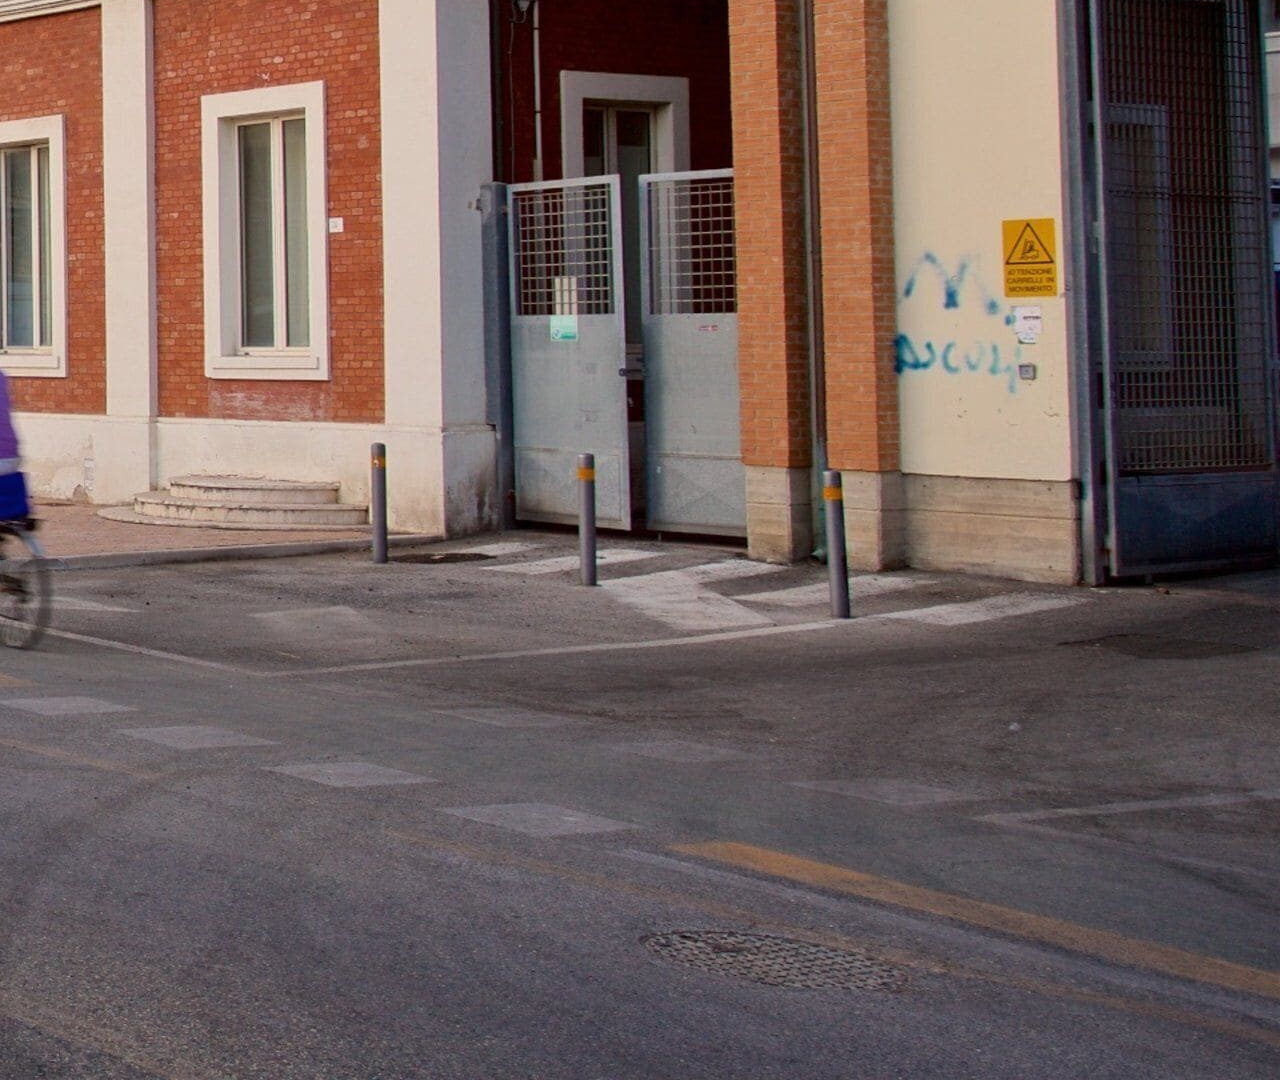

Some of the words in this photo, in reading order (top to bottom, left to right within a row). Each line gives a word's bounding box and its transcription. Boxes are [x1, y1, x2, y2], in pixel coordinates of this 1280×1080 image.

[1007, 268, 1053, 276] ATTENZIONE
[1007, 276, 1042, 284] CARRELLI
[1045, 276, 1054, 284] IN
[1008, 284, 1053, 293] MOVIMENTO
